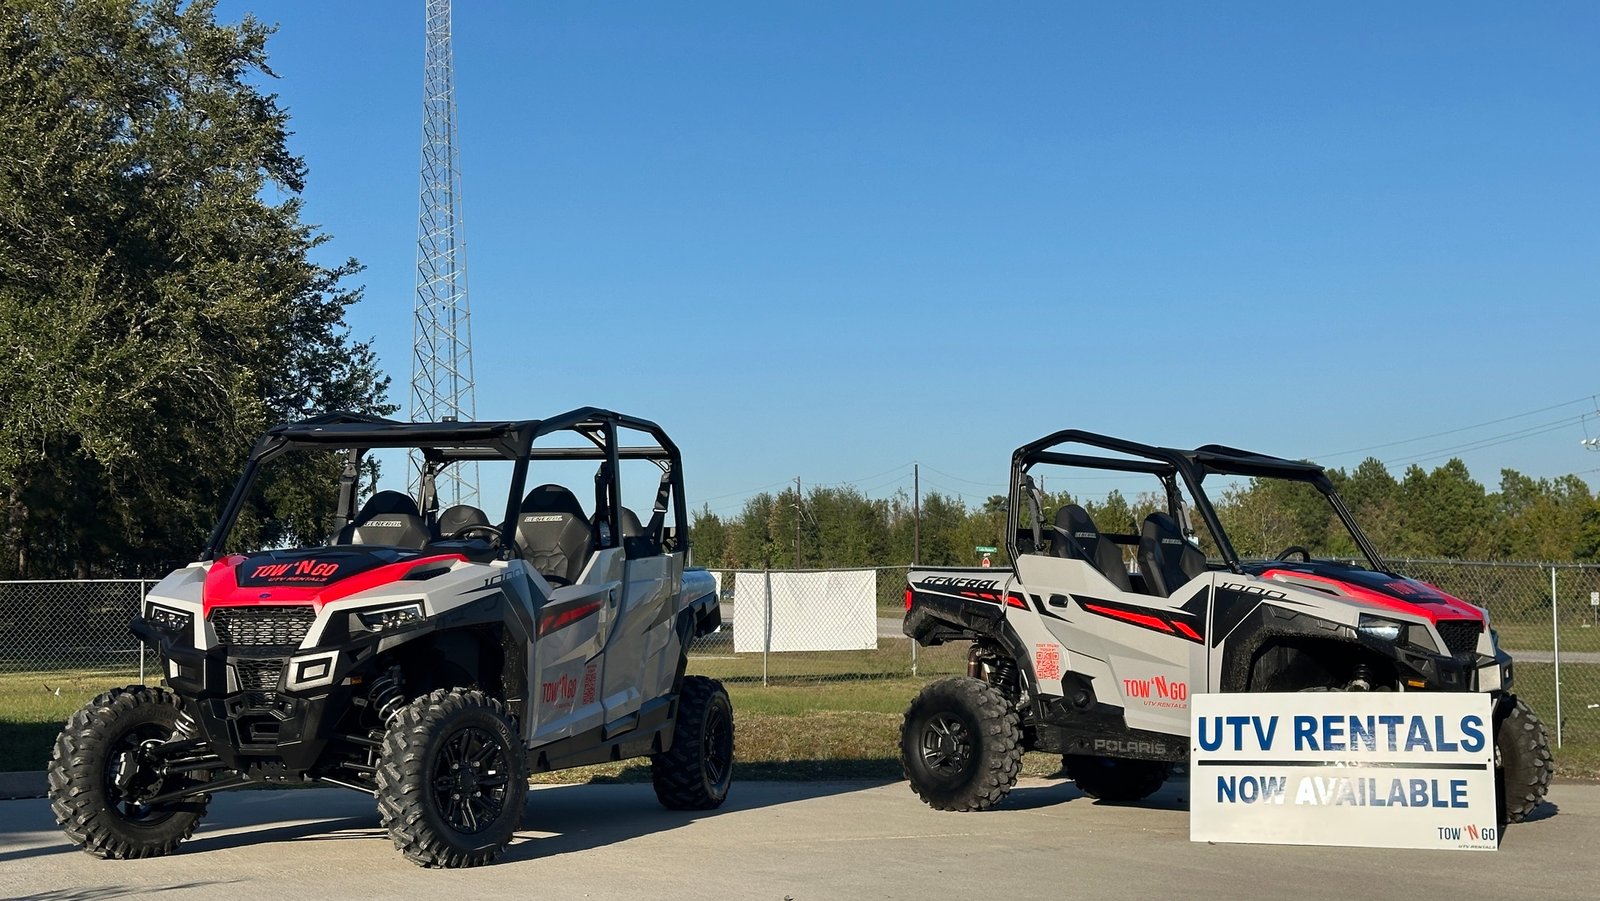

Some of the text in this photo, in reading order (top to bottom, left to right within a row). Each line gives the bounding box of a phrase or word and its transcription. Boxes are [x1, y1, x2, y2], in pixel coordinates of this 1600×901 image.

[251, 563, 293, 579] TOW
[311, 563, 339, 577] GO
[921, 575, 1001, 591] GENERAL
[1220, 581, 1287, 602] 1000
[543, 682, 558, 703] TOW
[1123, 679, 1150, 698] TOW
[1170, 682, 1187, 702] GO
[1157, 701, 1187, 709] RENTALS
[1198, 714, 1486, 753] UTV RENTALS
[1094, 739, 1167, 755] POLARIS
[1217, 775, 1470, 809] NOW AVAILABLE
[1437, 826, 1461, 840] TOW
[1481, 827, 1496, 841] GO
